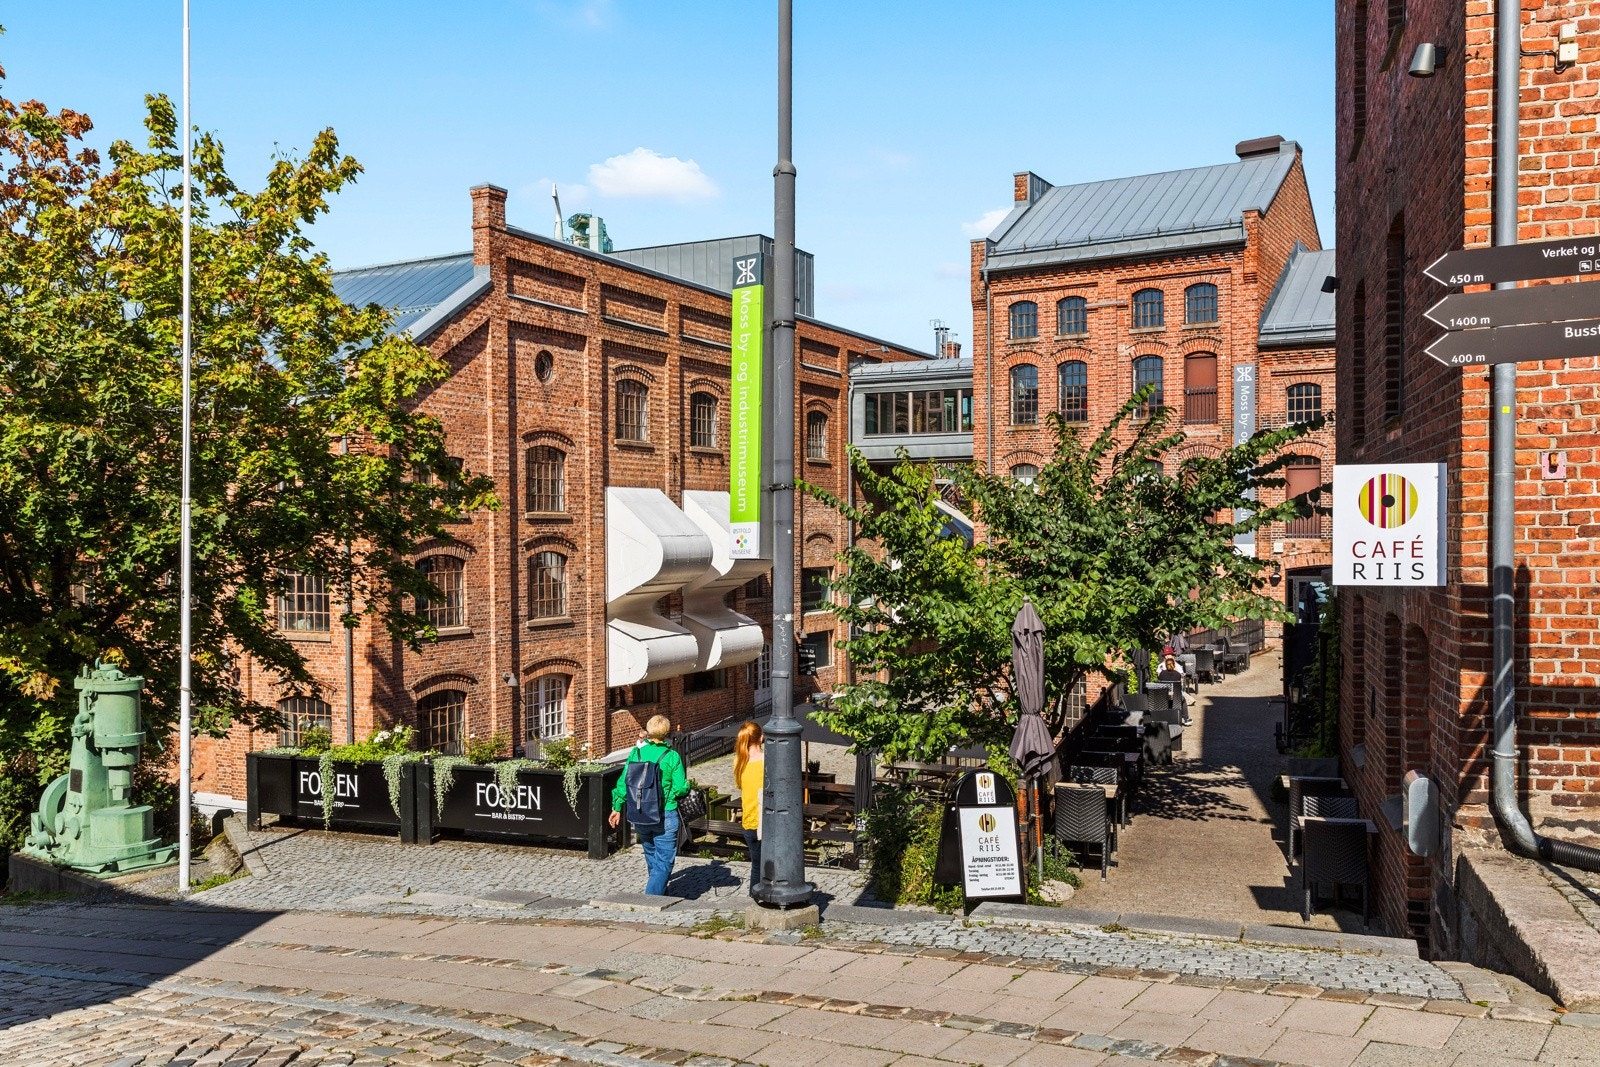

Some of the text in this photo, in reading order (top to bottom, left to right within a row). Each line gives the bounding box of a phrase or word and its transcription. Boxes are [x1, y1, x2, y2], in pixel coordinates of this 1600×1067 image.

[1542, 245, 1578, 258] Verket
[1581, 246, 1595, 256] og
[1449, 274, 1484, 285] 450 m
[1449, 316, 1491, 327] 1400 m
[1451, 354, 1486, 364] 400 m
[736, 290, 752, 512] Moss by- og industrimuseum
[1240, 385, 1250, 411] Moss
[1239, 413, 1250, 430] by-
[1351, 534, 1425, 559] CAFÉ
[1352, 562, 1425, 581] RIIS
[978, 834, 1000, 845] CAFÉ
[979, 844, 1001, 852] RIIS
[971, 855, 1010, 863] ÅPNINGSTIDER:
